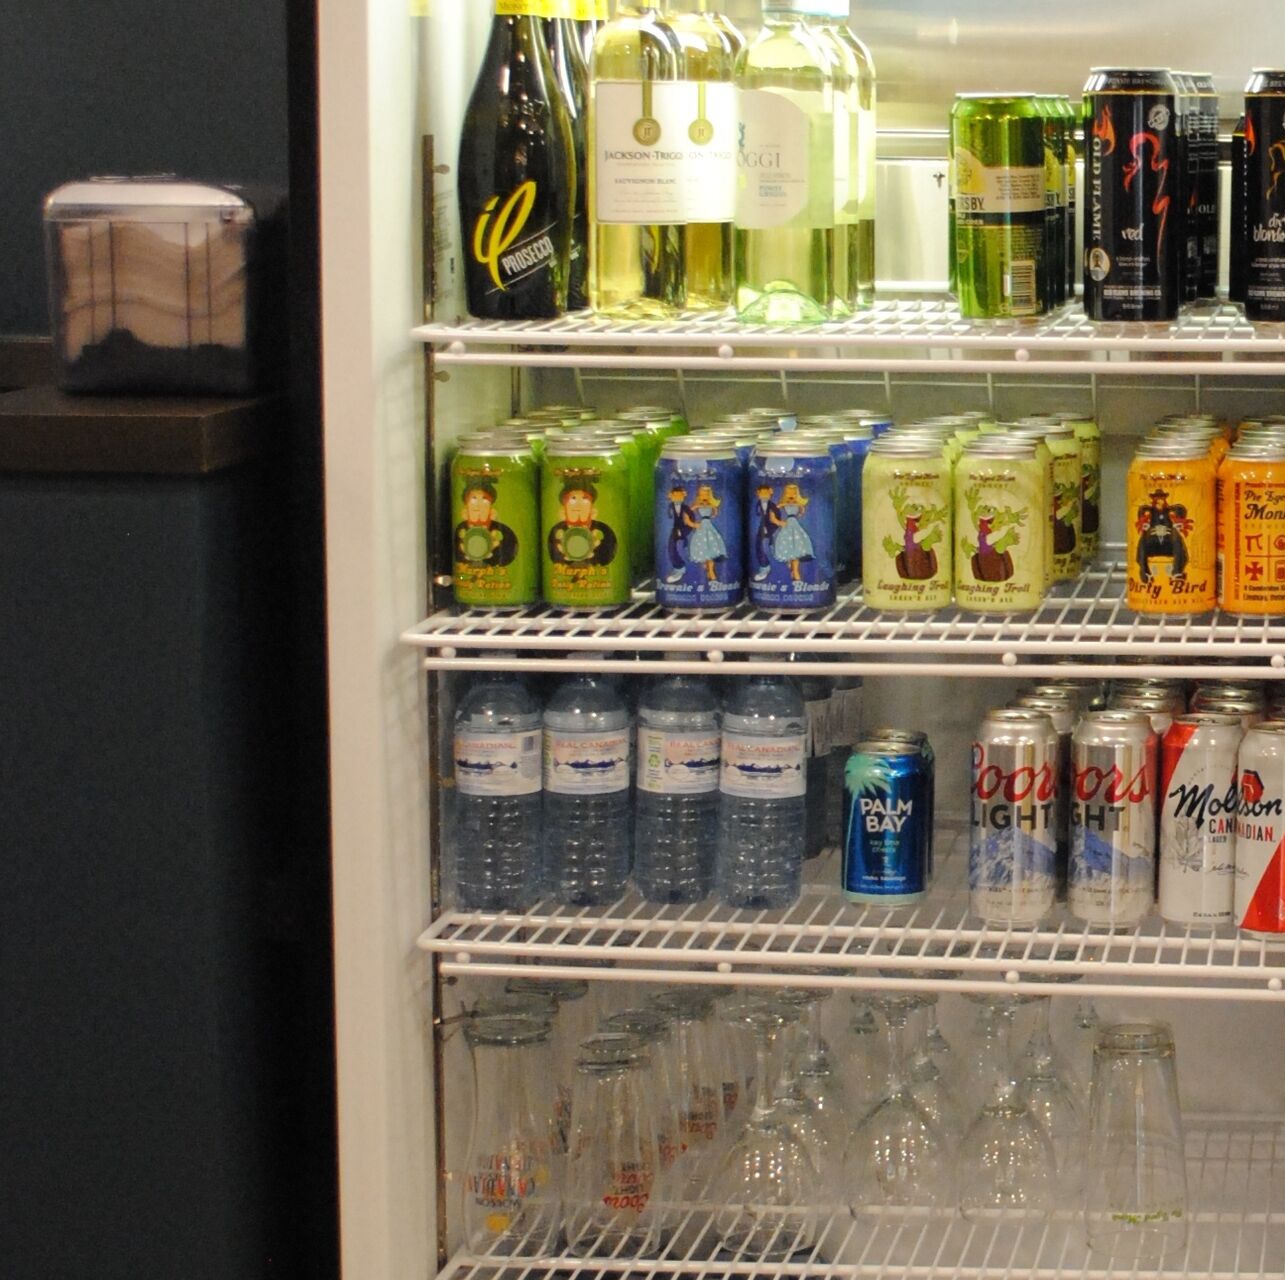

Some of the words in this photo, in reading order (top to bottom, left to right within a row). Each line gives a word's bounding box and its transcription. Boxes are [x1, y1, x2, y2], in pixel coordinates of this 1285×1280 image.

[502, 236, 554, 276] PROSECCO
[1003, 583, 1031, 593] Troll
[1169, 576, 1208, 595] Bird
[860, 798, 913, 816] PALM
[866, 815, 907, 833] BAY
